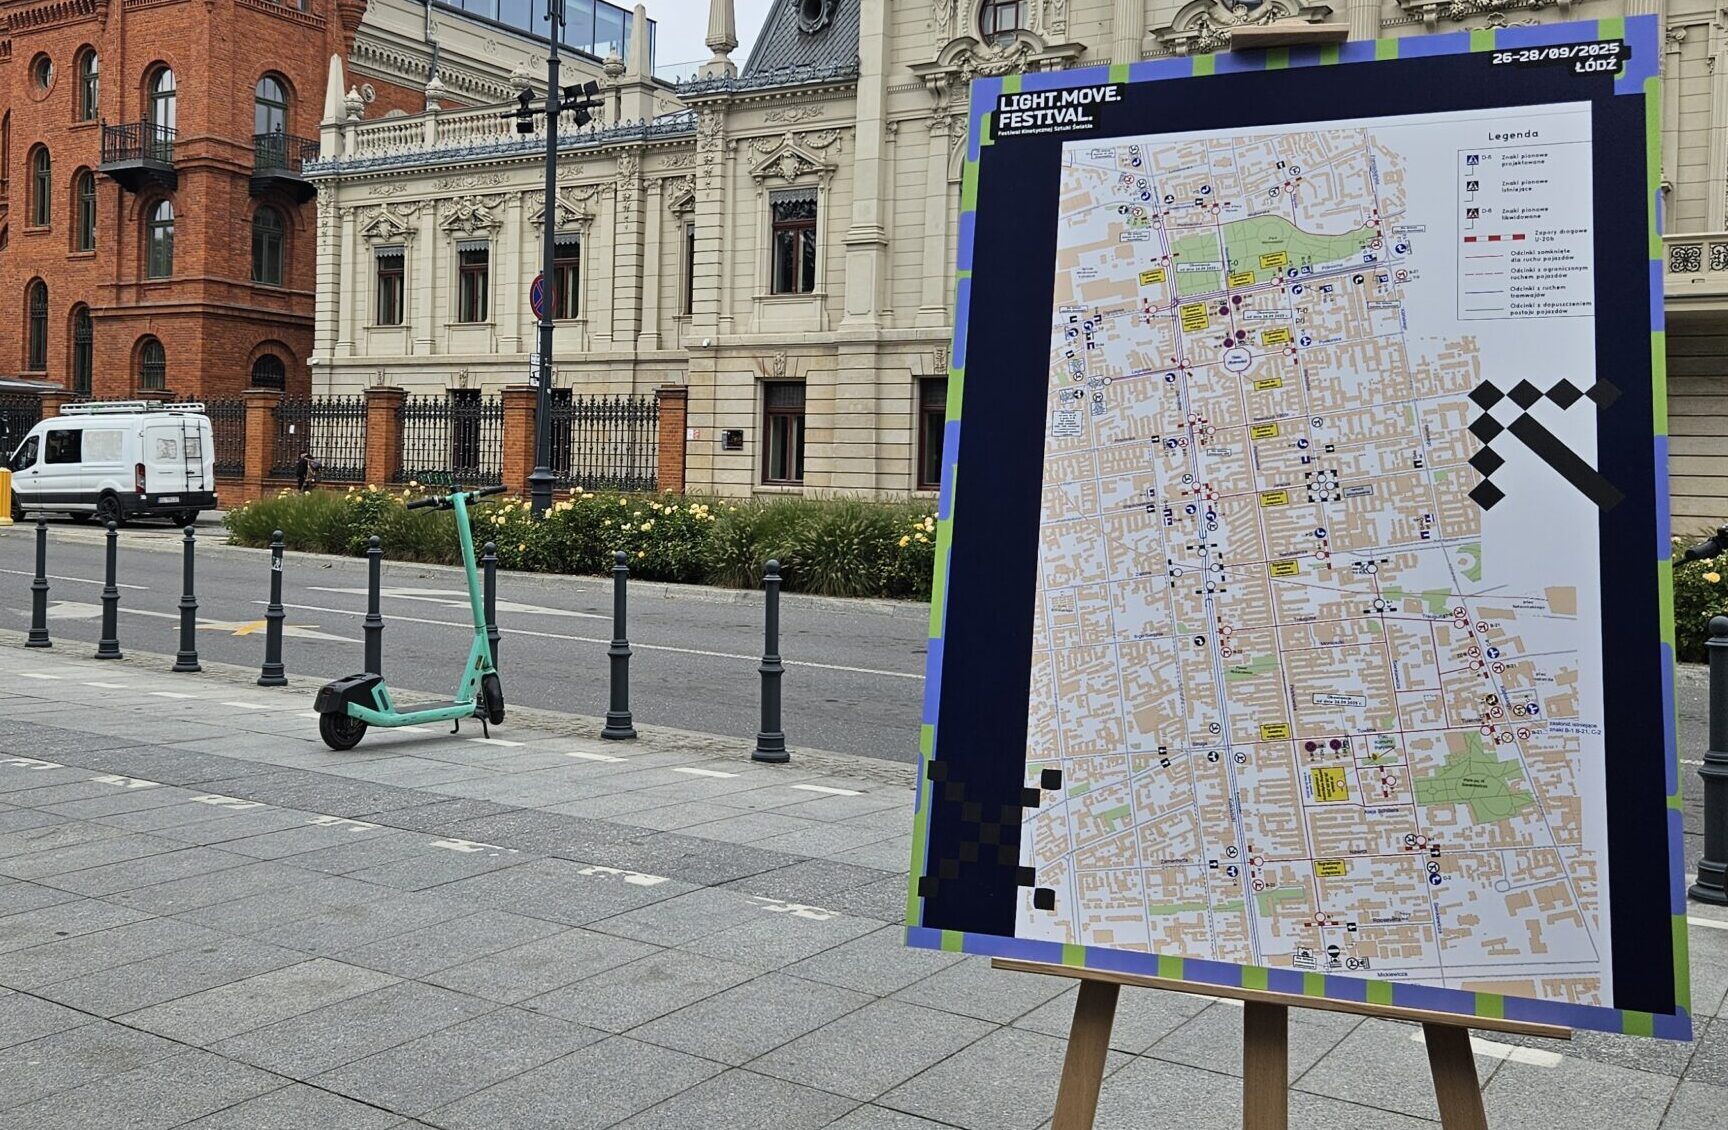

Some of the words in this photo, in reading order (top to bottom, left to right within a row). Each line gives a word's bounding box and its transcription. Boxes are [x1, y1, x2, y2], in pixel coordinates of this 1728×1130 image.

[1493, 42, 1620, 64] 26-28/09/2025
[1574, 56, 1616, 72] ŁÓDŹ
[1000, 86, 1121, 112] LIGHT.MOVE.
[1000, 107, 1093, 128] FESTIVAL.
[1488, 130, 1539, 141] Legenda
